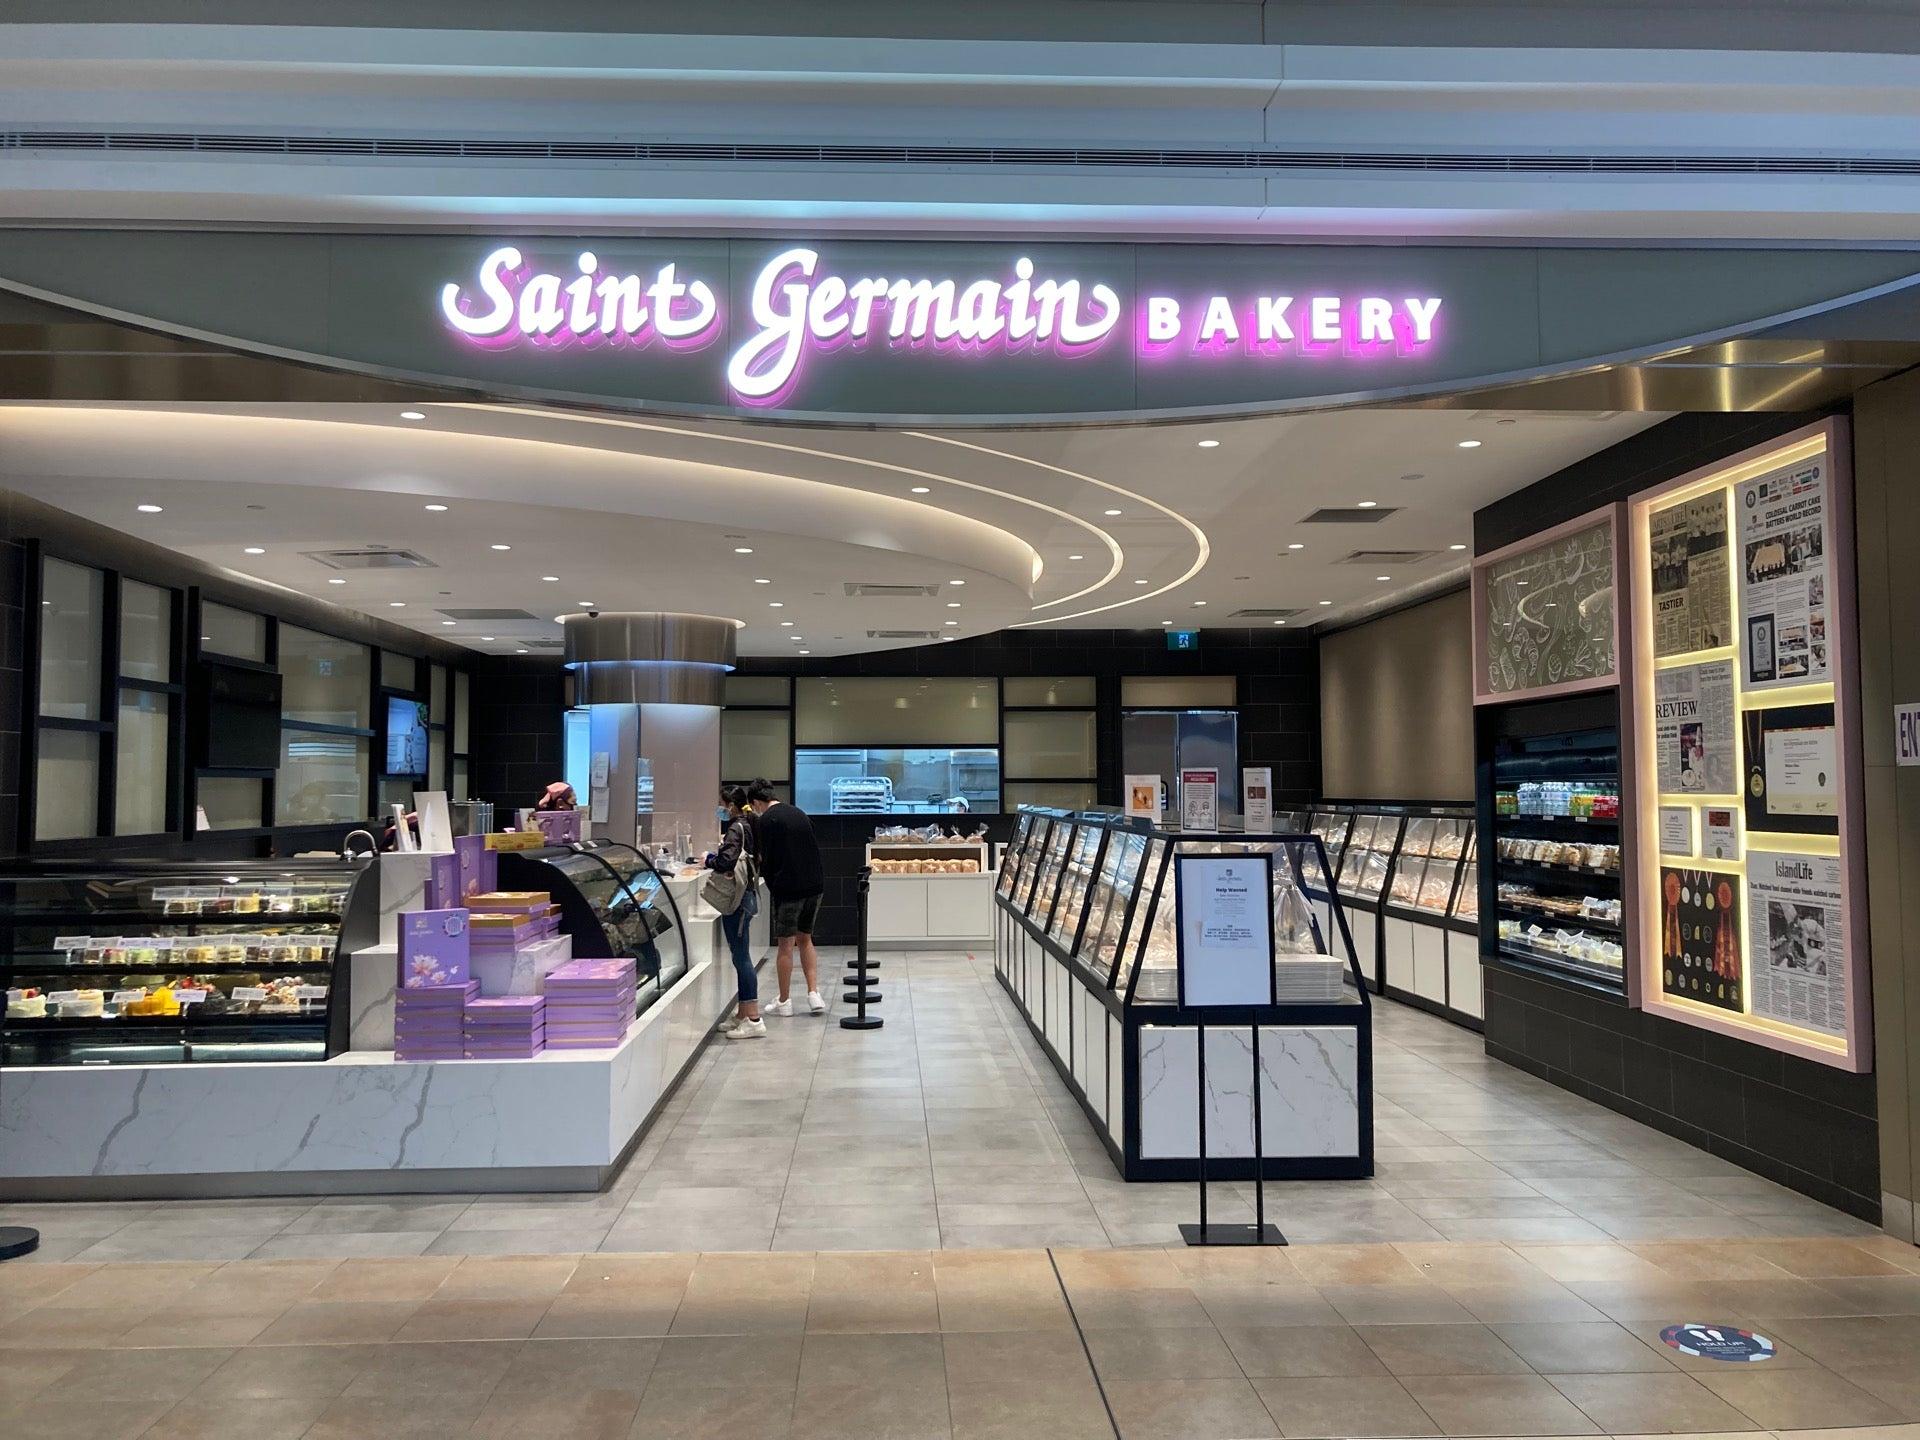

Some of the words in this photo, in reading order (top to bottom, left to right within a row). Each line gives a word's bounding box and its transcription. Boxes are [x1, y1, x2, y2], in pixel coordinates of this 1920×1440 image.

[442, 247, 717, 338] Saint
[728, 248, 1121, 396] Germain
[1148, 296, 1443, 341] BAKERY
[1765, 506, 1787, 519] COLOSSAL
[1789, 500, 1807, 512] CARROT
[1808, 495, 1821, 506] CAKE
[1765, 516, 1785, 528] BATTERS
[1785, 511, 1802, 523] WORLD
[1803, 505, 1821, 517] RECORD
[1658, 597, 1684, 612] TASTIER
[1655, 700, 1698, 719] REVIEW
[1775, 860, 1814, 881] IslandLife
